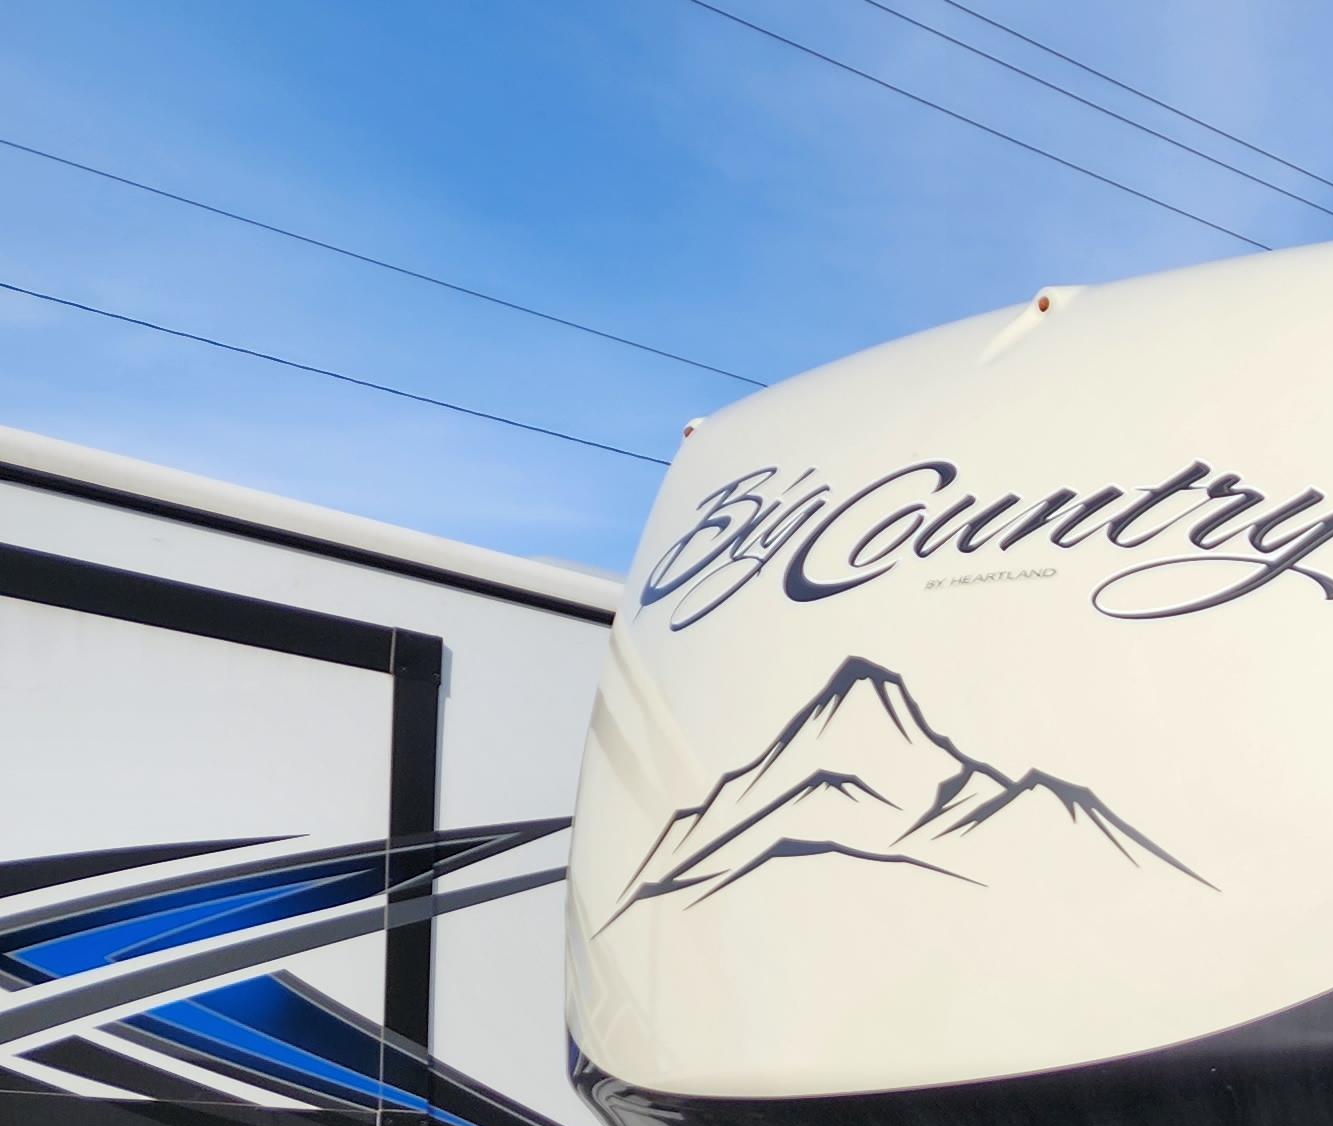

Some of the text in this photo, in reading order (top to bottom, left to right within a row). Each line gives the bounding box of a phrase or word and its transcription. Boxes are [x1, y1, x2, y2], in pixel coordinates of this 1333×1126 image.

[633, 465, 831, 632] Big
[924, 567, 1057, 590] BY HEARTLAND
